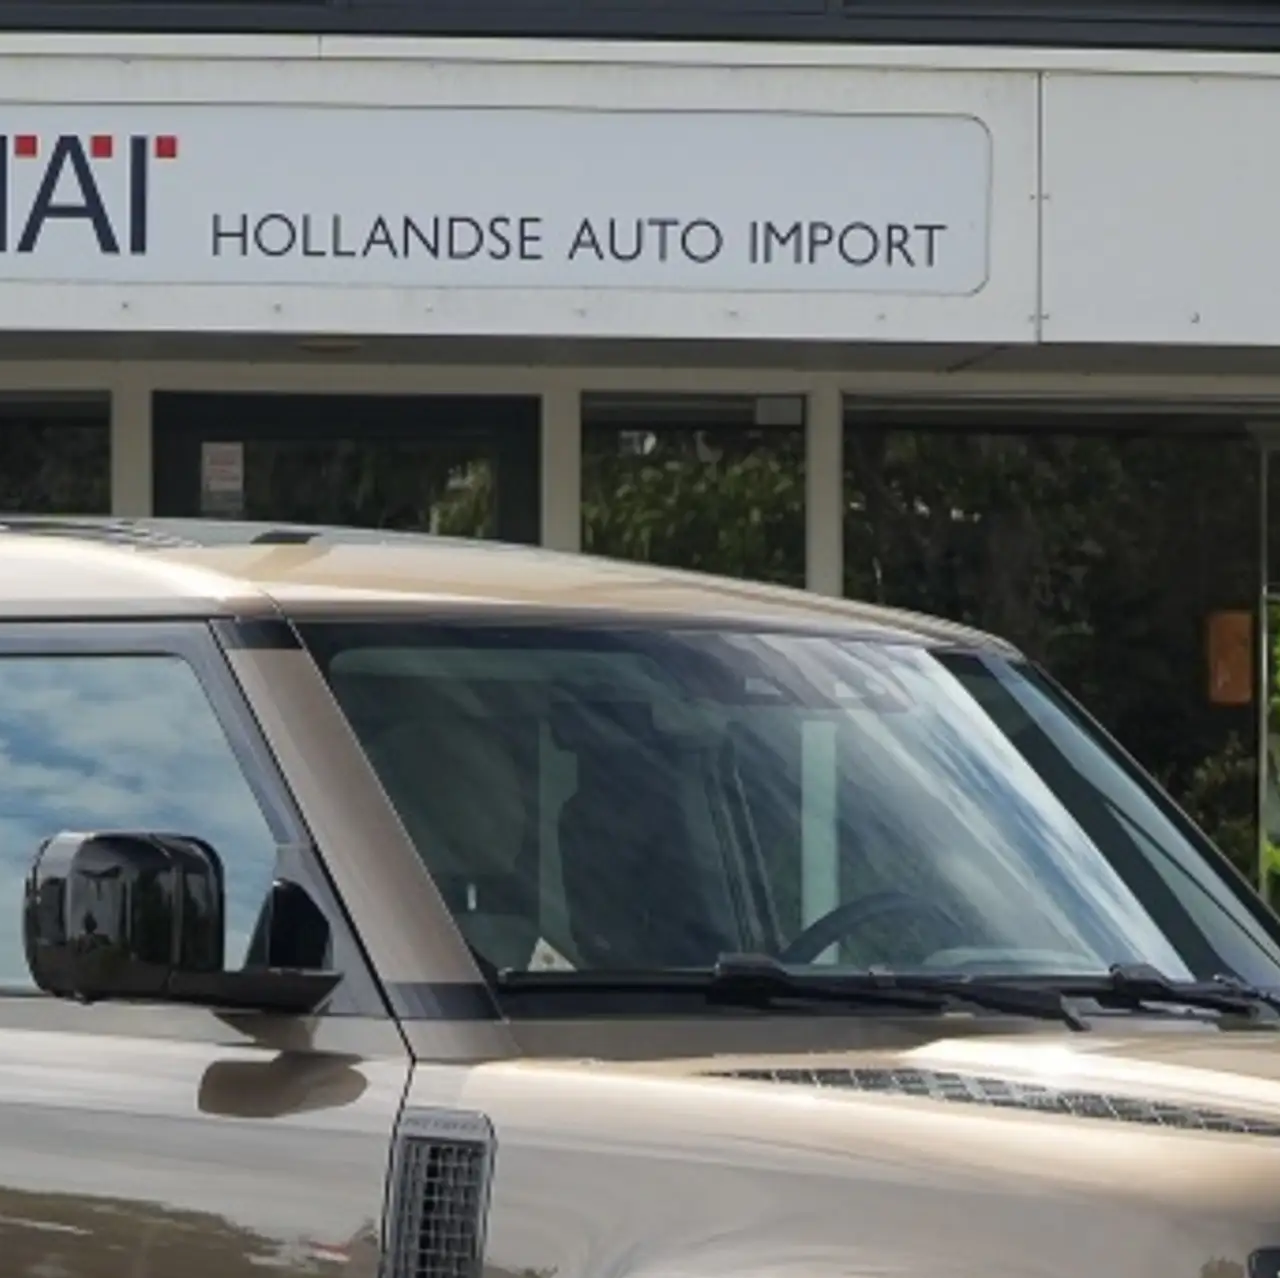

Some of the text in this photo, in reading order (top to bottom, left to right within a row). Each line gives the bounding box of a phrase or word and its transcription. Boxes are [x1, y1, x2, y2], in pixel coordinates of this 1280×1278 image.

[212, 212, 543, 261] HOLLANDSE
[567, 216, 724, 264] AUTO
[749, 220, 948, 267] IMPORT
